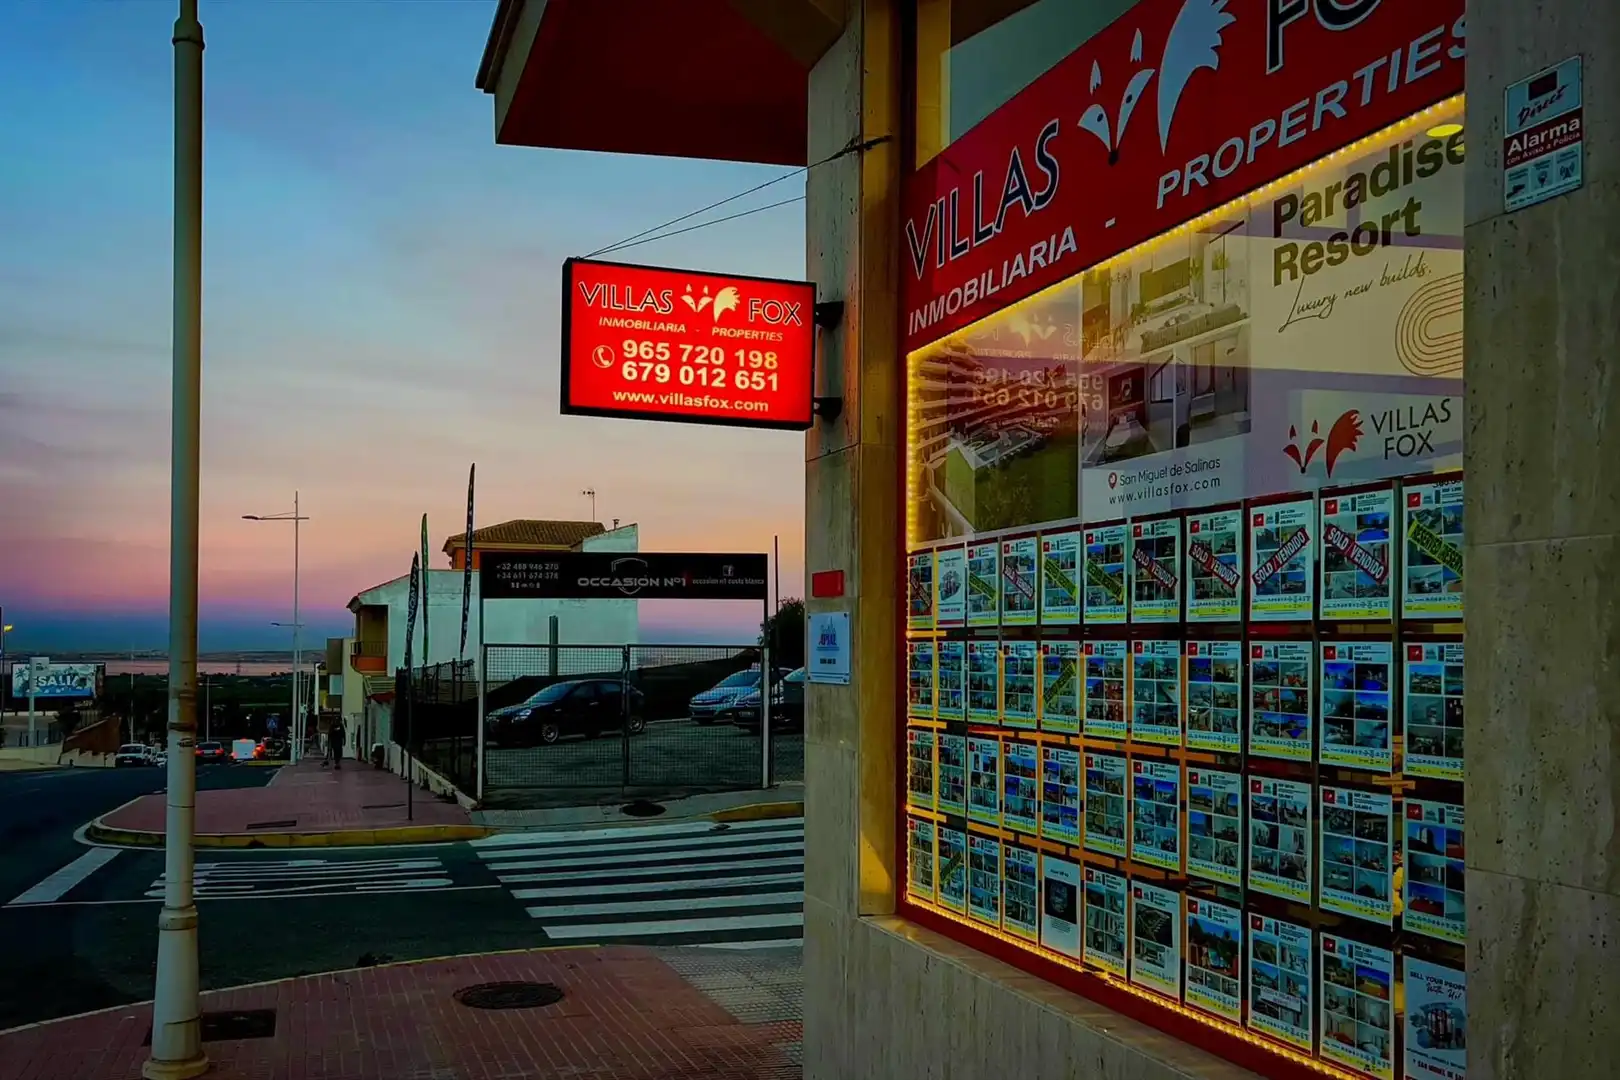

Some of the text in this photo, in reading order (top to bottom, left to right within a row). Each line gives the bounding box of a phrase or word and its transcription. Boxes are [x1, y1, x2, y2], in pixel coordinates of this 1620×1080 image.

[1508, 118, 1580, 156] Alarma
[1522, 146, 1544, 162] Aviso
[905, 118, 1059, 281] VILLAS
[1273, 132, 1464, 238] Paradise
[1274, 196, 1422, 288] Resort
[908, 225, 1078, 336] INMOBILIARIA
[1278, 250, 1432, 333] Luxury new builds.
[578, 281, 803, 327] VILLAS FOX
[598, 316, 687, 334] INMOBILIARIA
[711, 327, 783, 342] PROPERTIES
[622, 339, 778, 370] 965 720 198
[621, 362, 778, 392] 679 012 651
[613, 390, 769, 413] www.villasfox.com
[1371, 398, 1452, 435] VILLAS
[1384, 430, 1435, 460] FOX
[1119, 456, 1221, 487] San Miguel de Salinas
[1108, 476, 1221, 505] www.villasfox.com
[1191, 545, 1208, 563] SOLD
[1210, 556, 1236, 585] VENDIDO
[1254, 561, 1272, 585] SOLD
[1276, 532, 1306, 564] VENDIDO
[1327, 527, 1349, 550] SOLD
[1350, 544, 1385, 580] VENDIDO
[577, 577, 660, 587] OCCASION
[1425, 975, 1443, 986] YOUR
